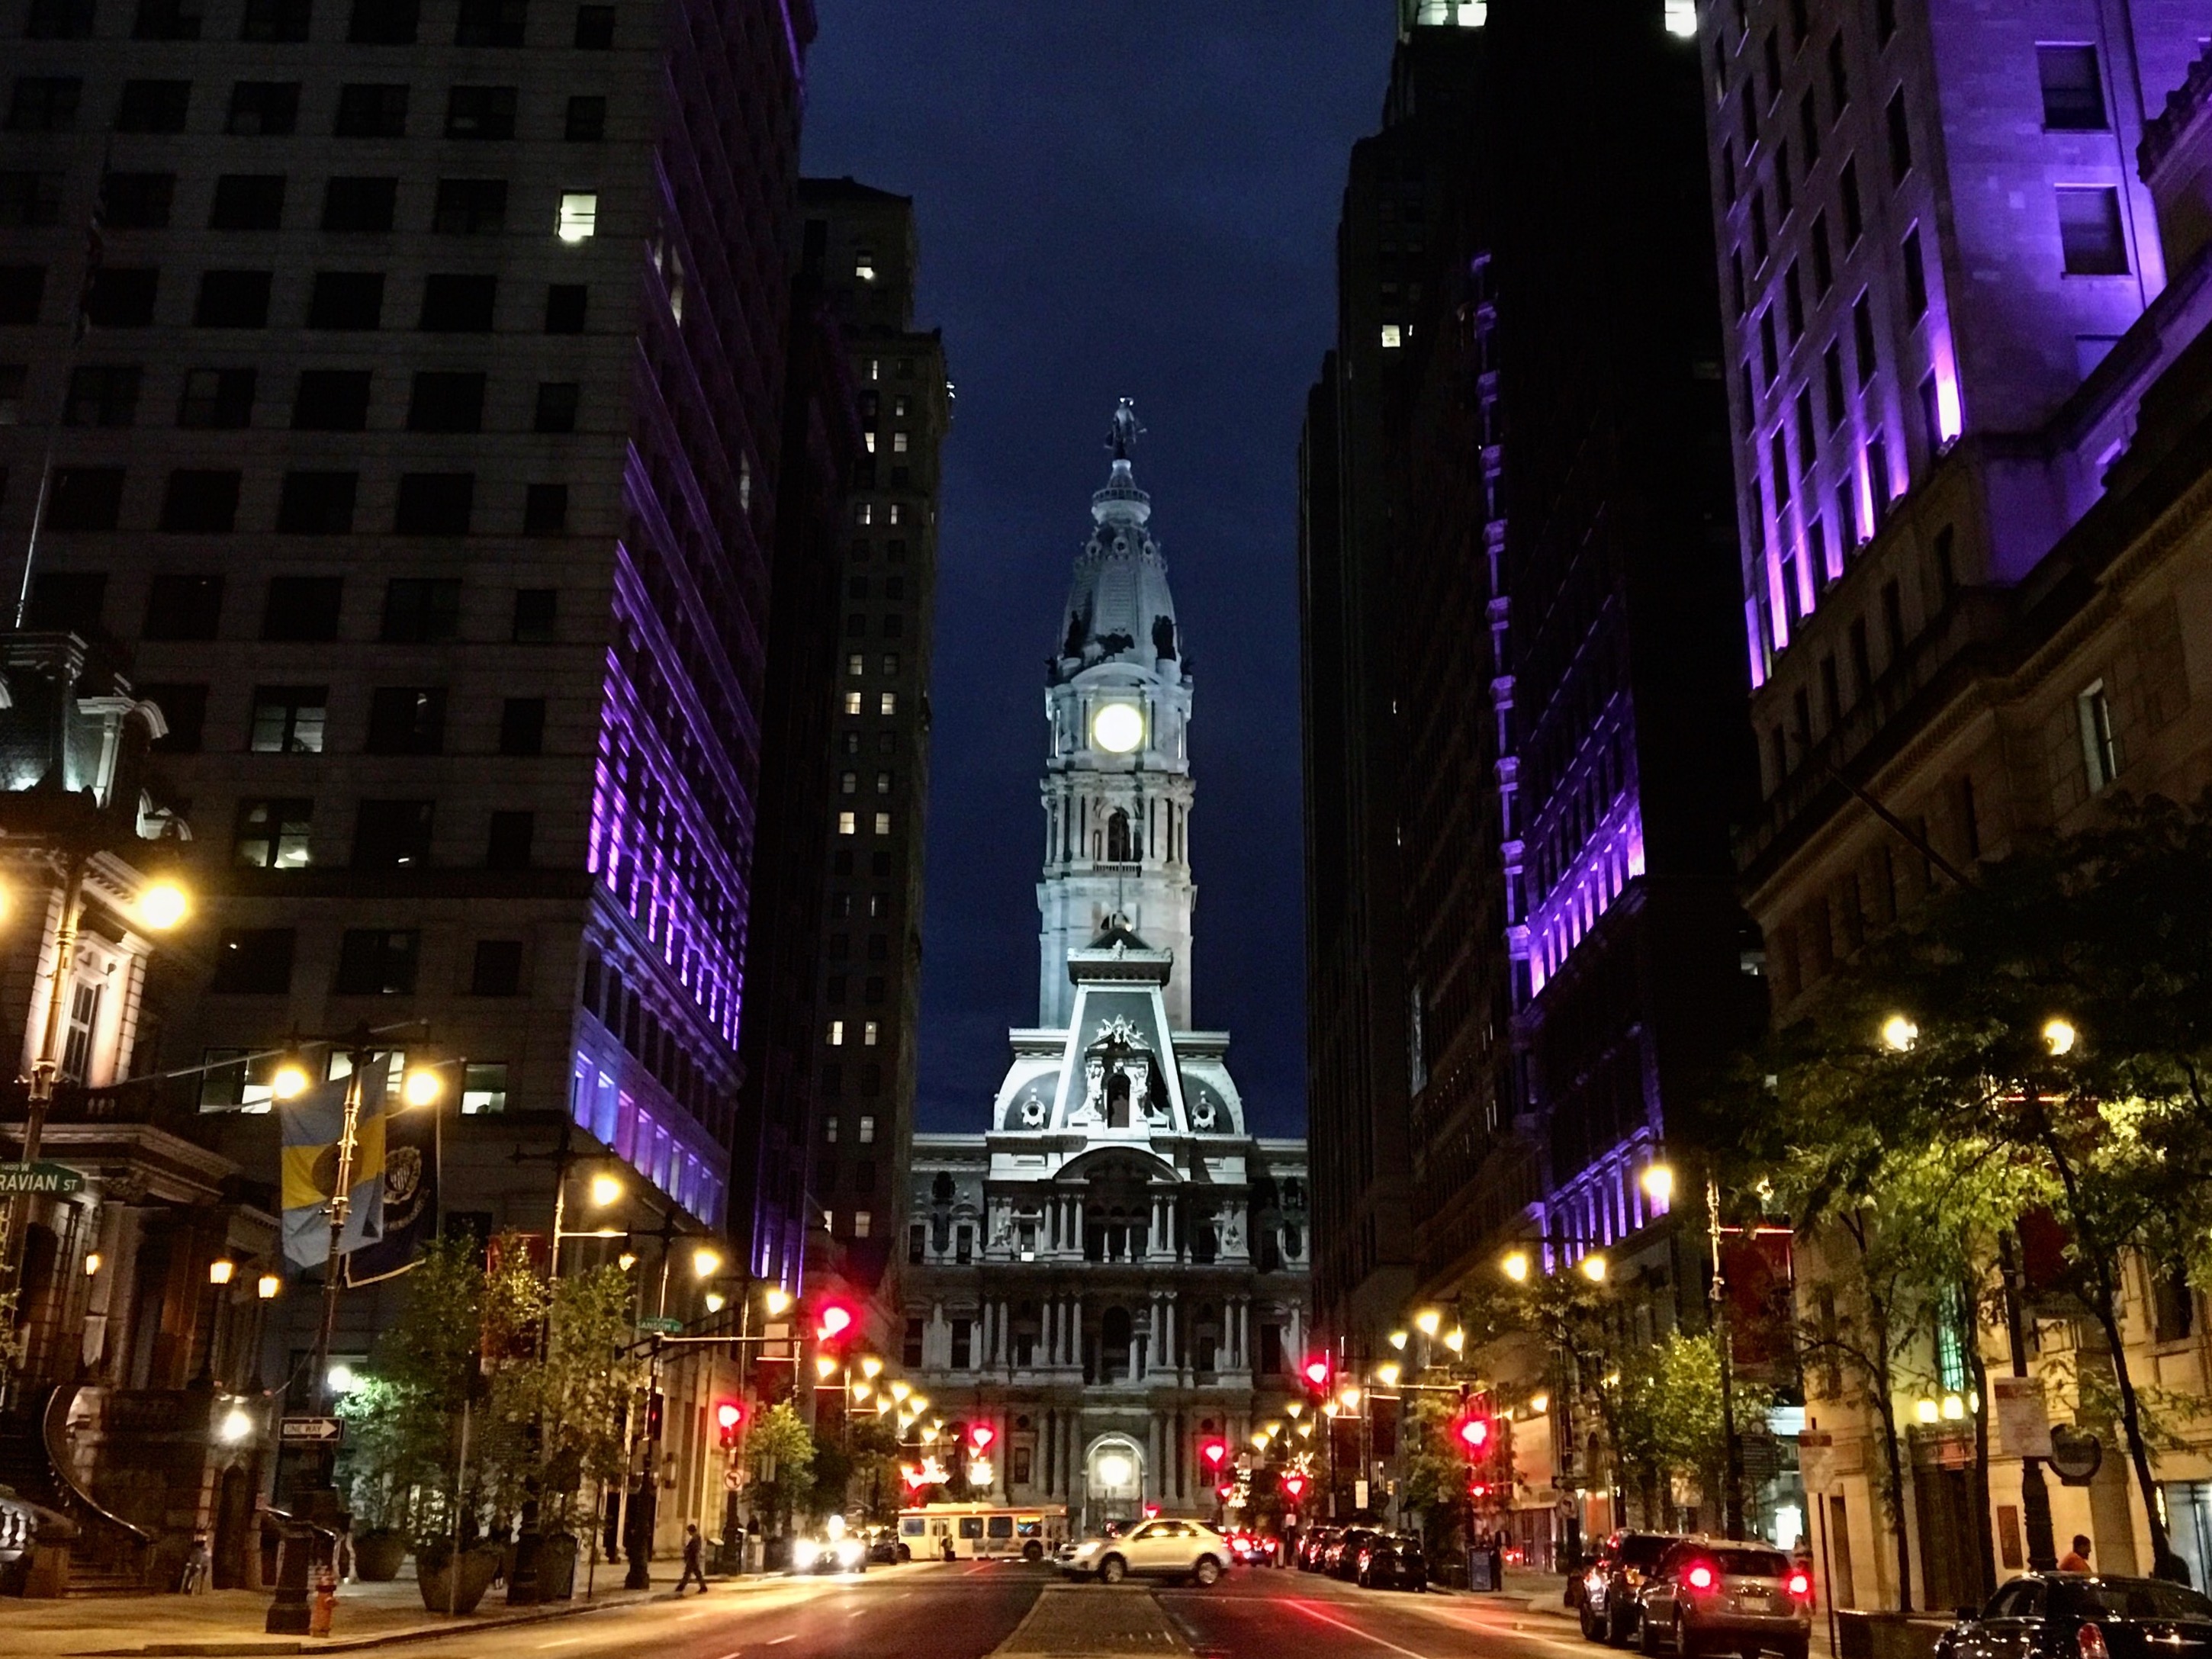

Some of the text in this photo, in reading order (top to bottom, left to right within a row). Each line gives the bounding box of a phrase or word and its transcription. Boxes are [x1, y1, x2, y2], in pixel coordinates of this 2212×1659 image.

[21, 1162, 30, 1172] W
[63, 1179, 78, 1191] ST
[286, 1424, 323, 1433] ONE WAY
